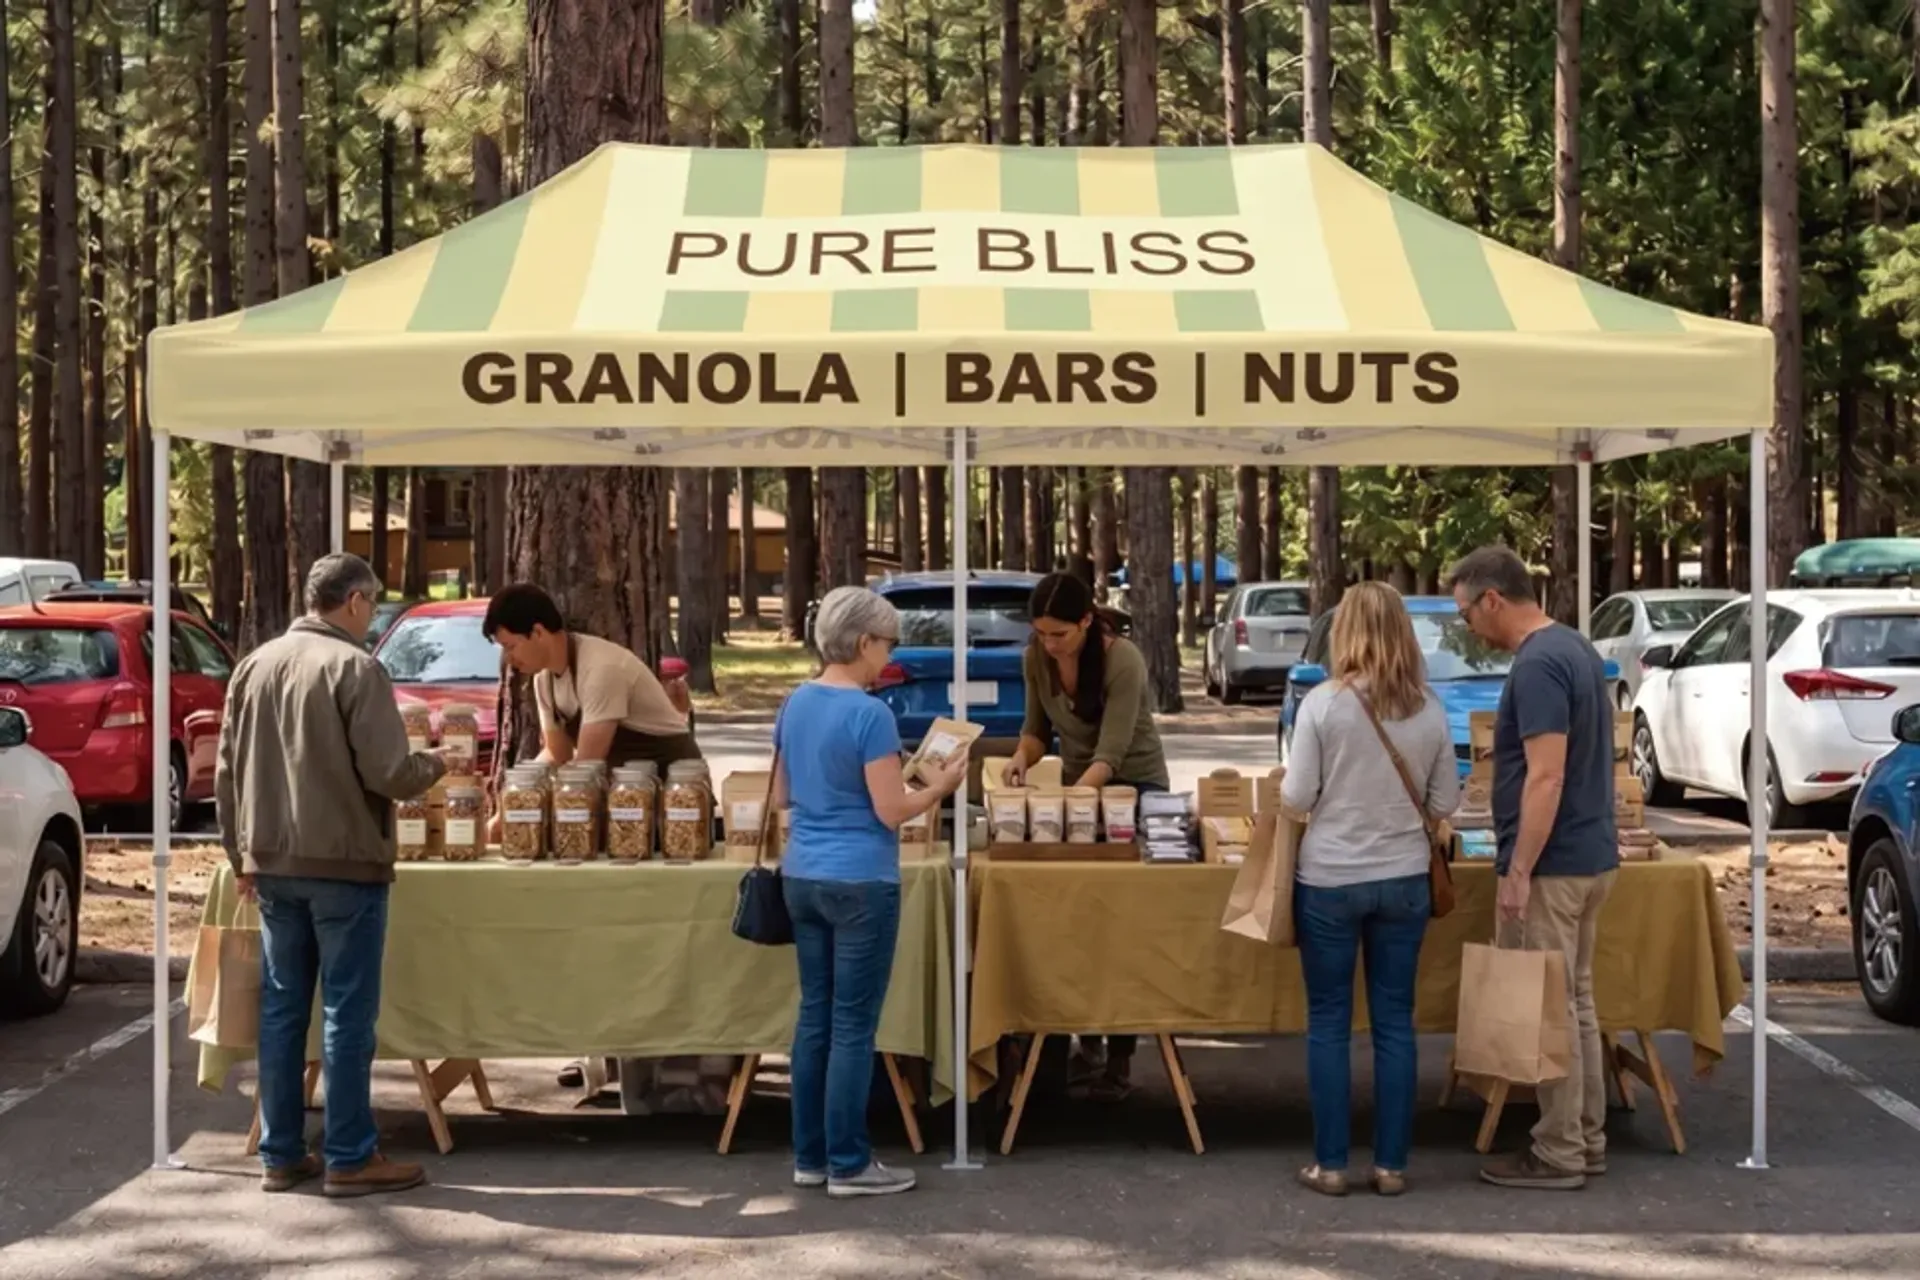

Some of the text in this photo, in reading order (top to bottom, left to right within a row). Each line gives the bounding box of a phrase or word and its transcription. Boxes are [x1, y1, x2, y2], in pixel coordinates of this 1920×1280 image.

[666, 228, 1256, 276] PURE BLISS
[461, 351, 860, 405] GRANOLA
[945, 351, 1158, 405] BARS
[1243, 351, 1461, 405] NUTS
